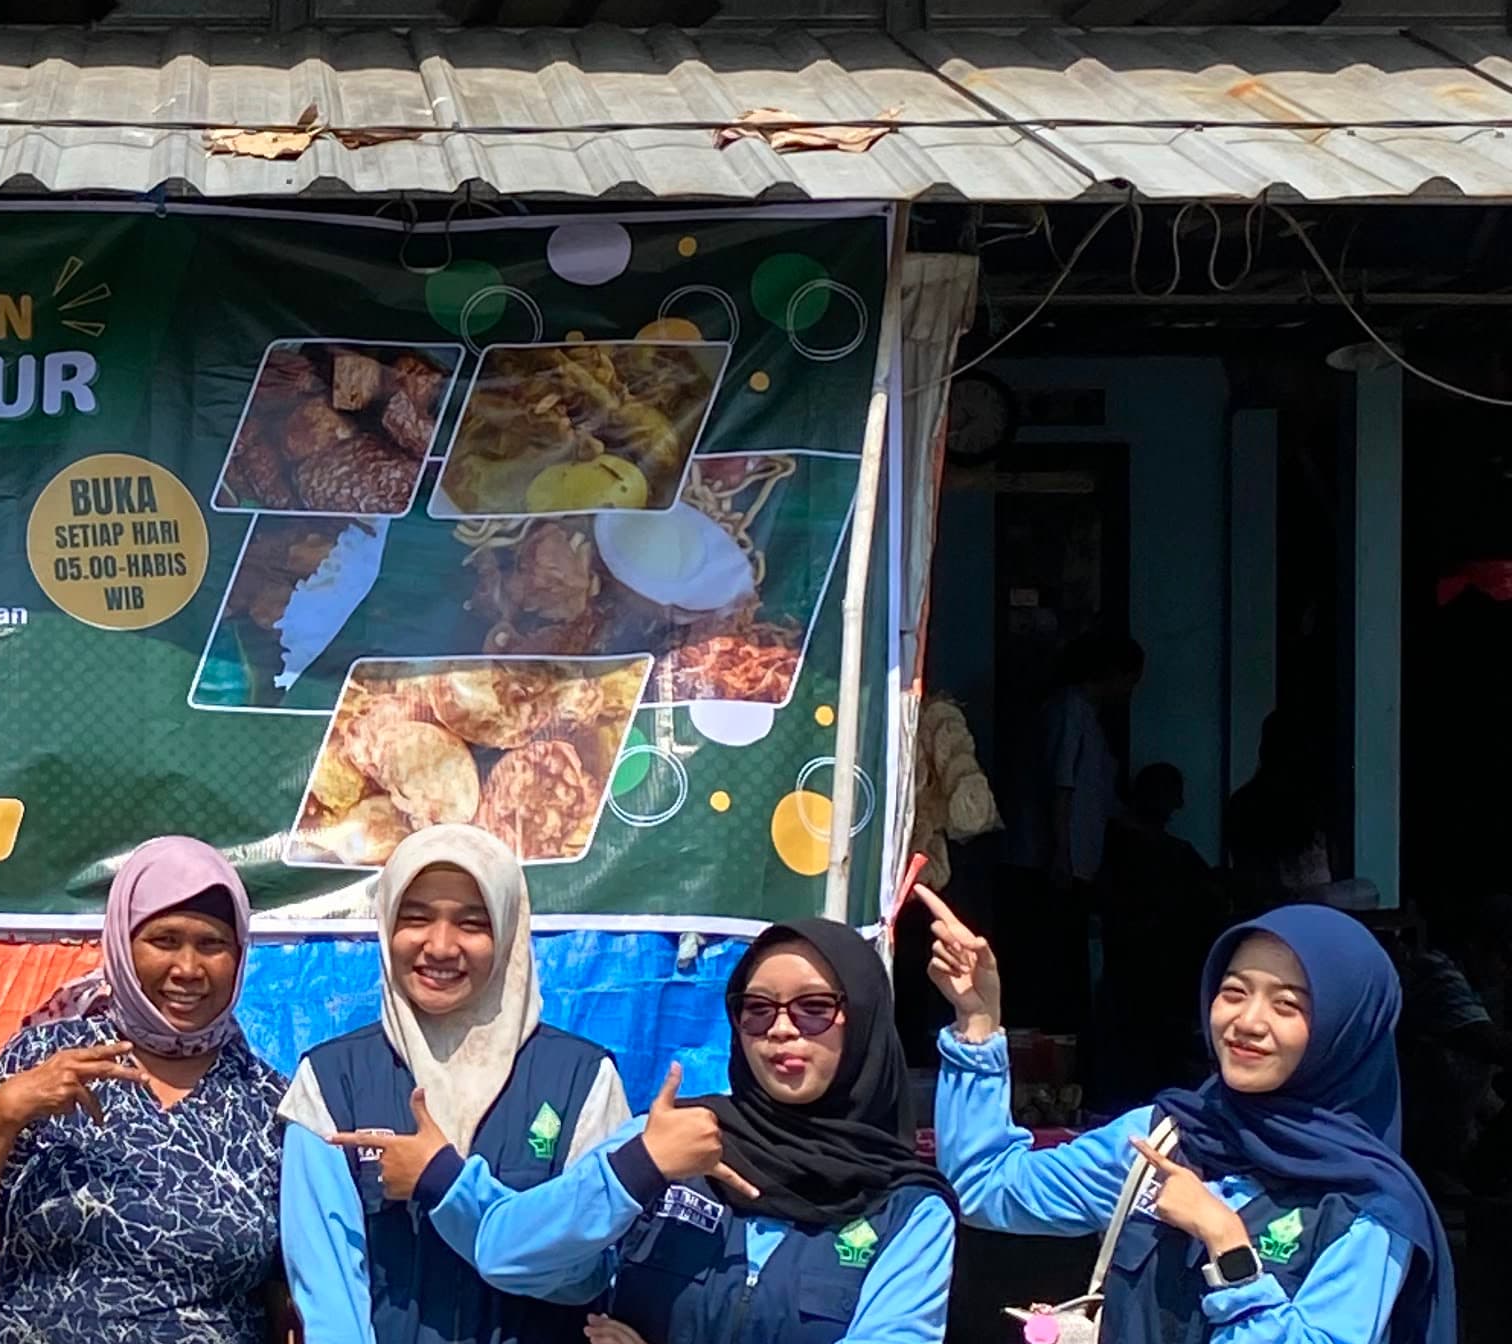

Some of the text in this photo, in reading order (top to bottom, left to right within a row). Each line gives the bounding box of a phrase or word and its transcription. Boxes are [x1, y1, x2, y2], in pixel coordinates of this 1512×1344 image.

[70, 476, 158, 516] BUKA
[55, 519, 180, 549] SETIAP HARI
[54, 553, 187, 581] 05.00-HABIS
[104, 586, 145, 611] WIB
